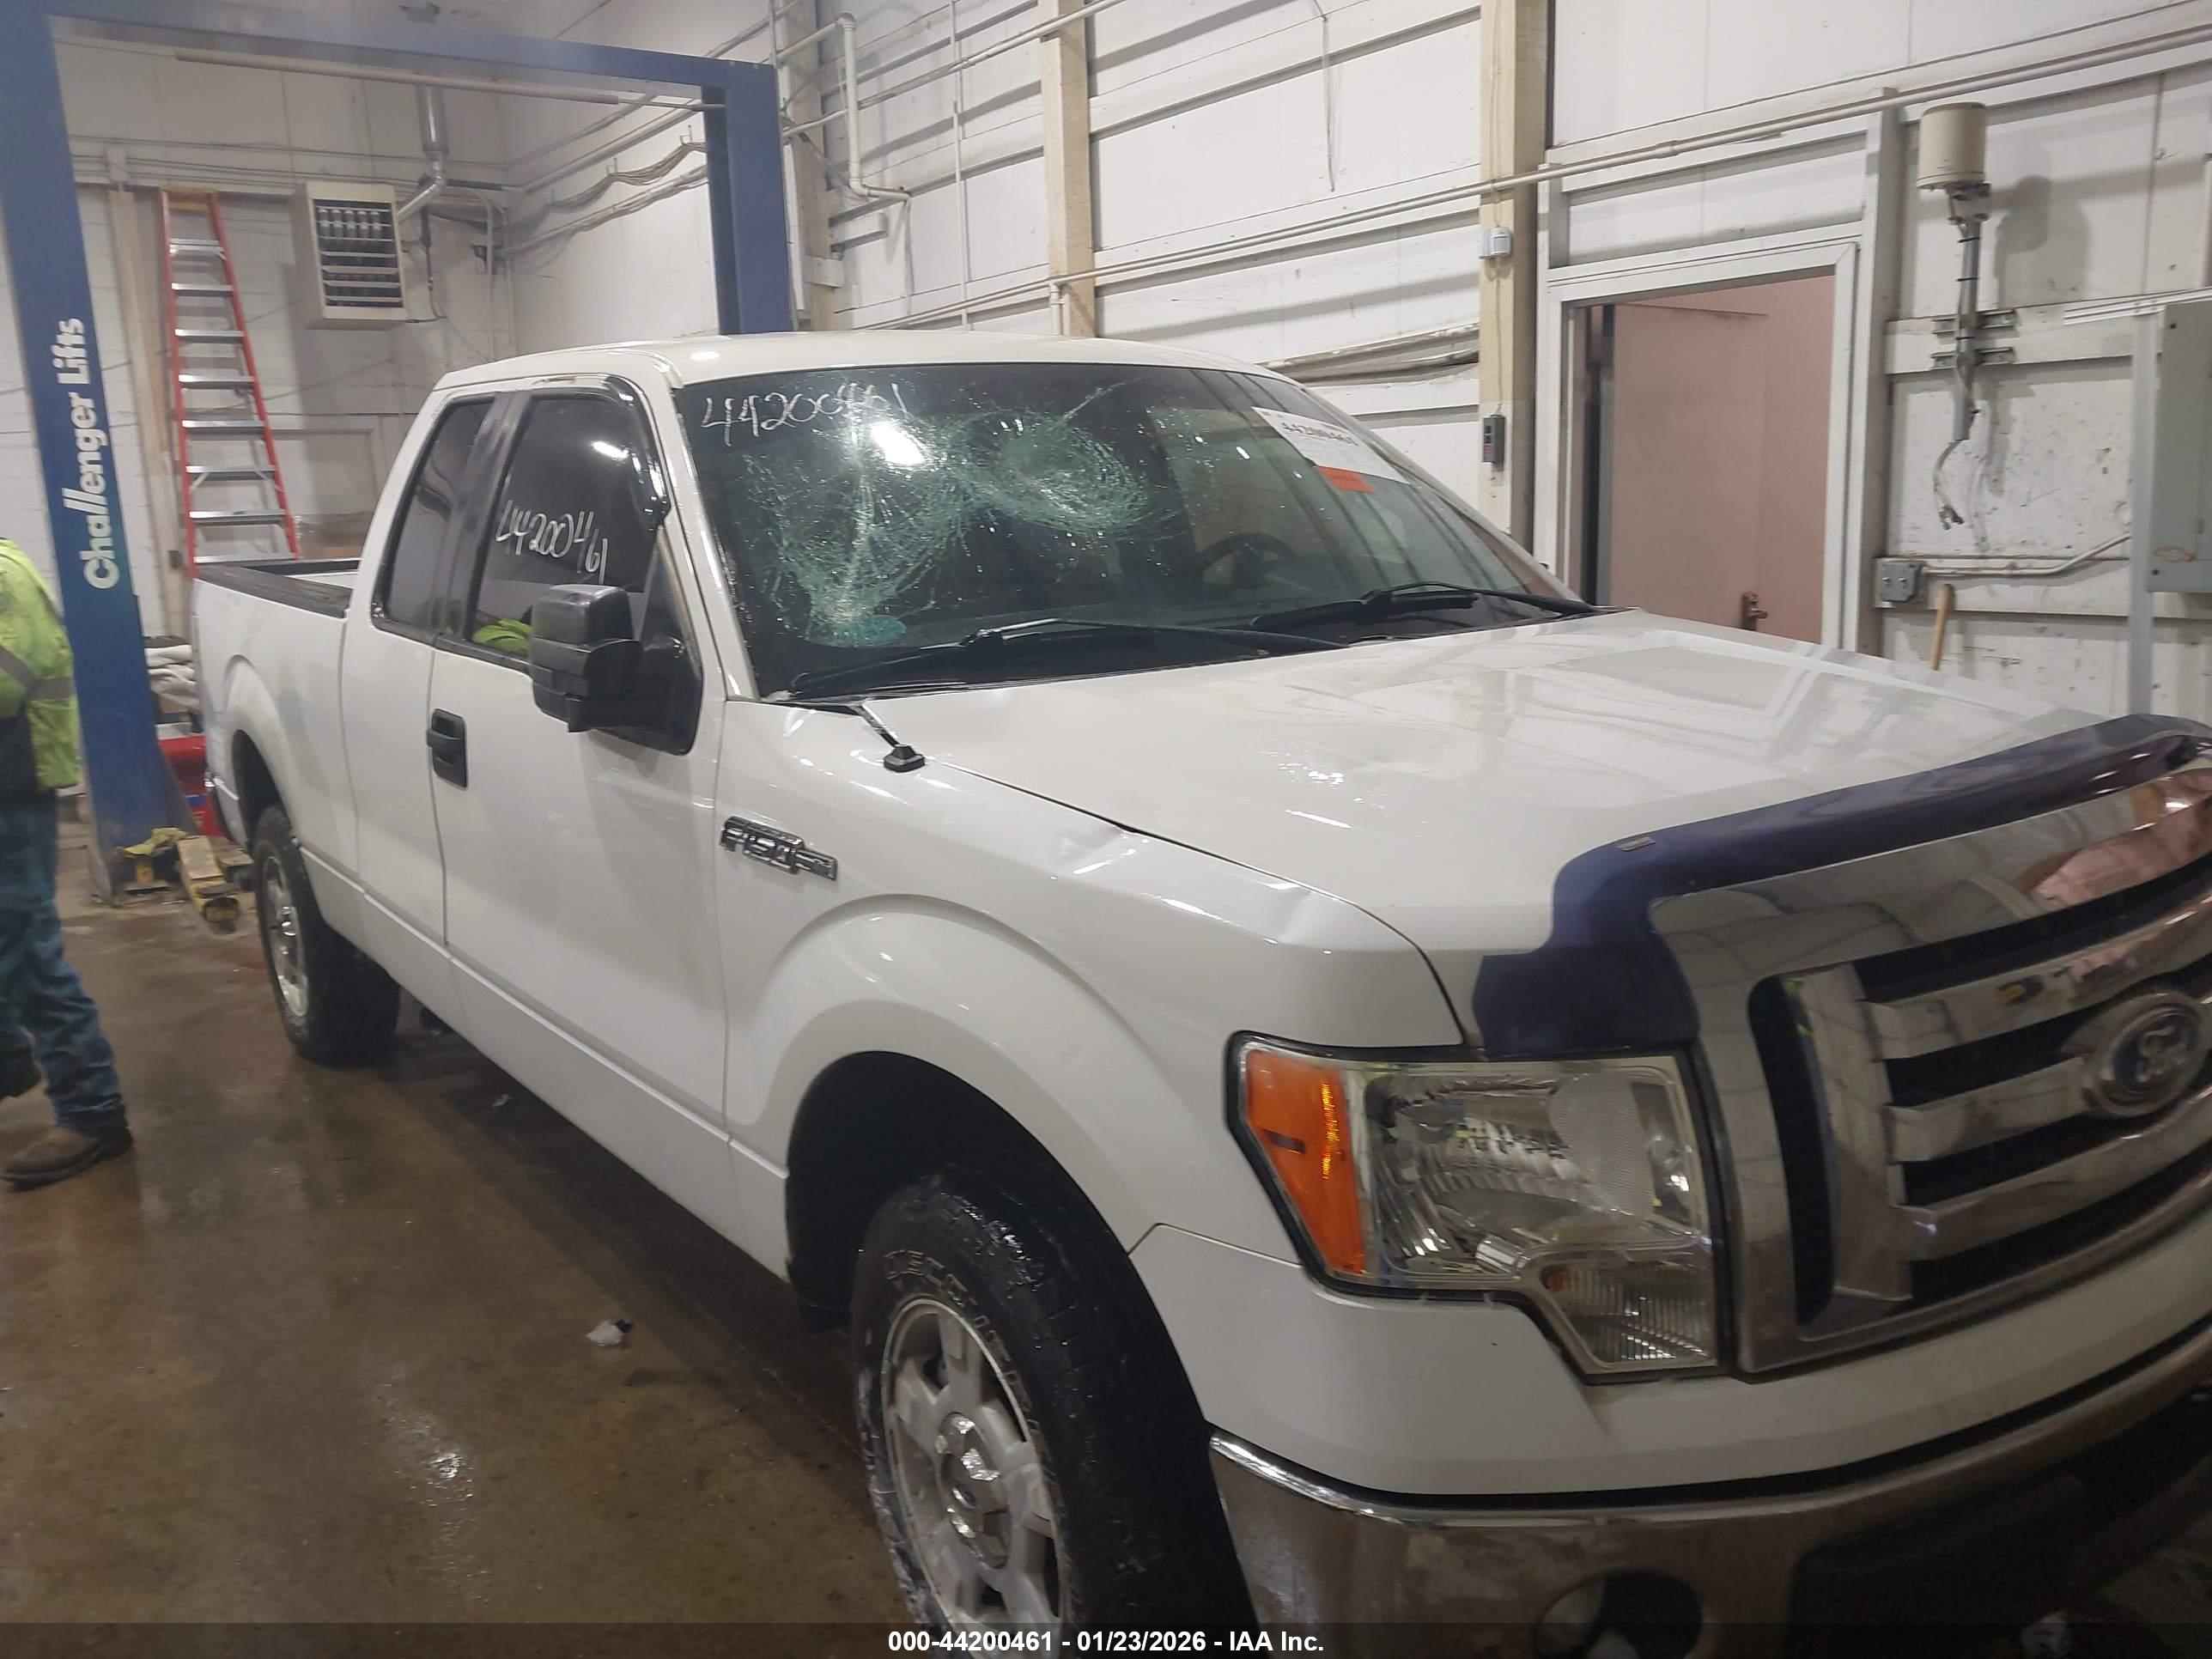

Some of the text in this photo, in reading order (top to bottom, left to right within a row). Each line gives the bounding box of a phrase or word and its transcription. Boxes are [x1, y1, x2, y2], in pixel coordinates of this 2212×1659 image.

[52, 317, 120, 590] Challenger Lifts
[495, 499, 609, 586] 44200461
